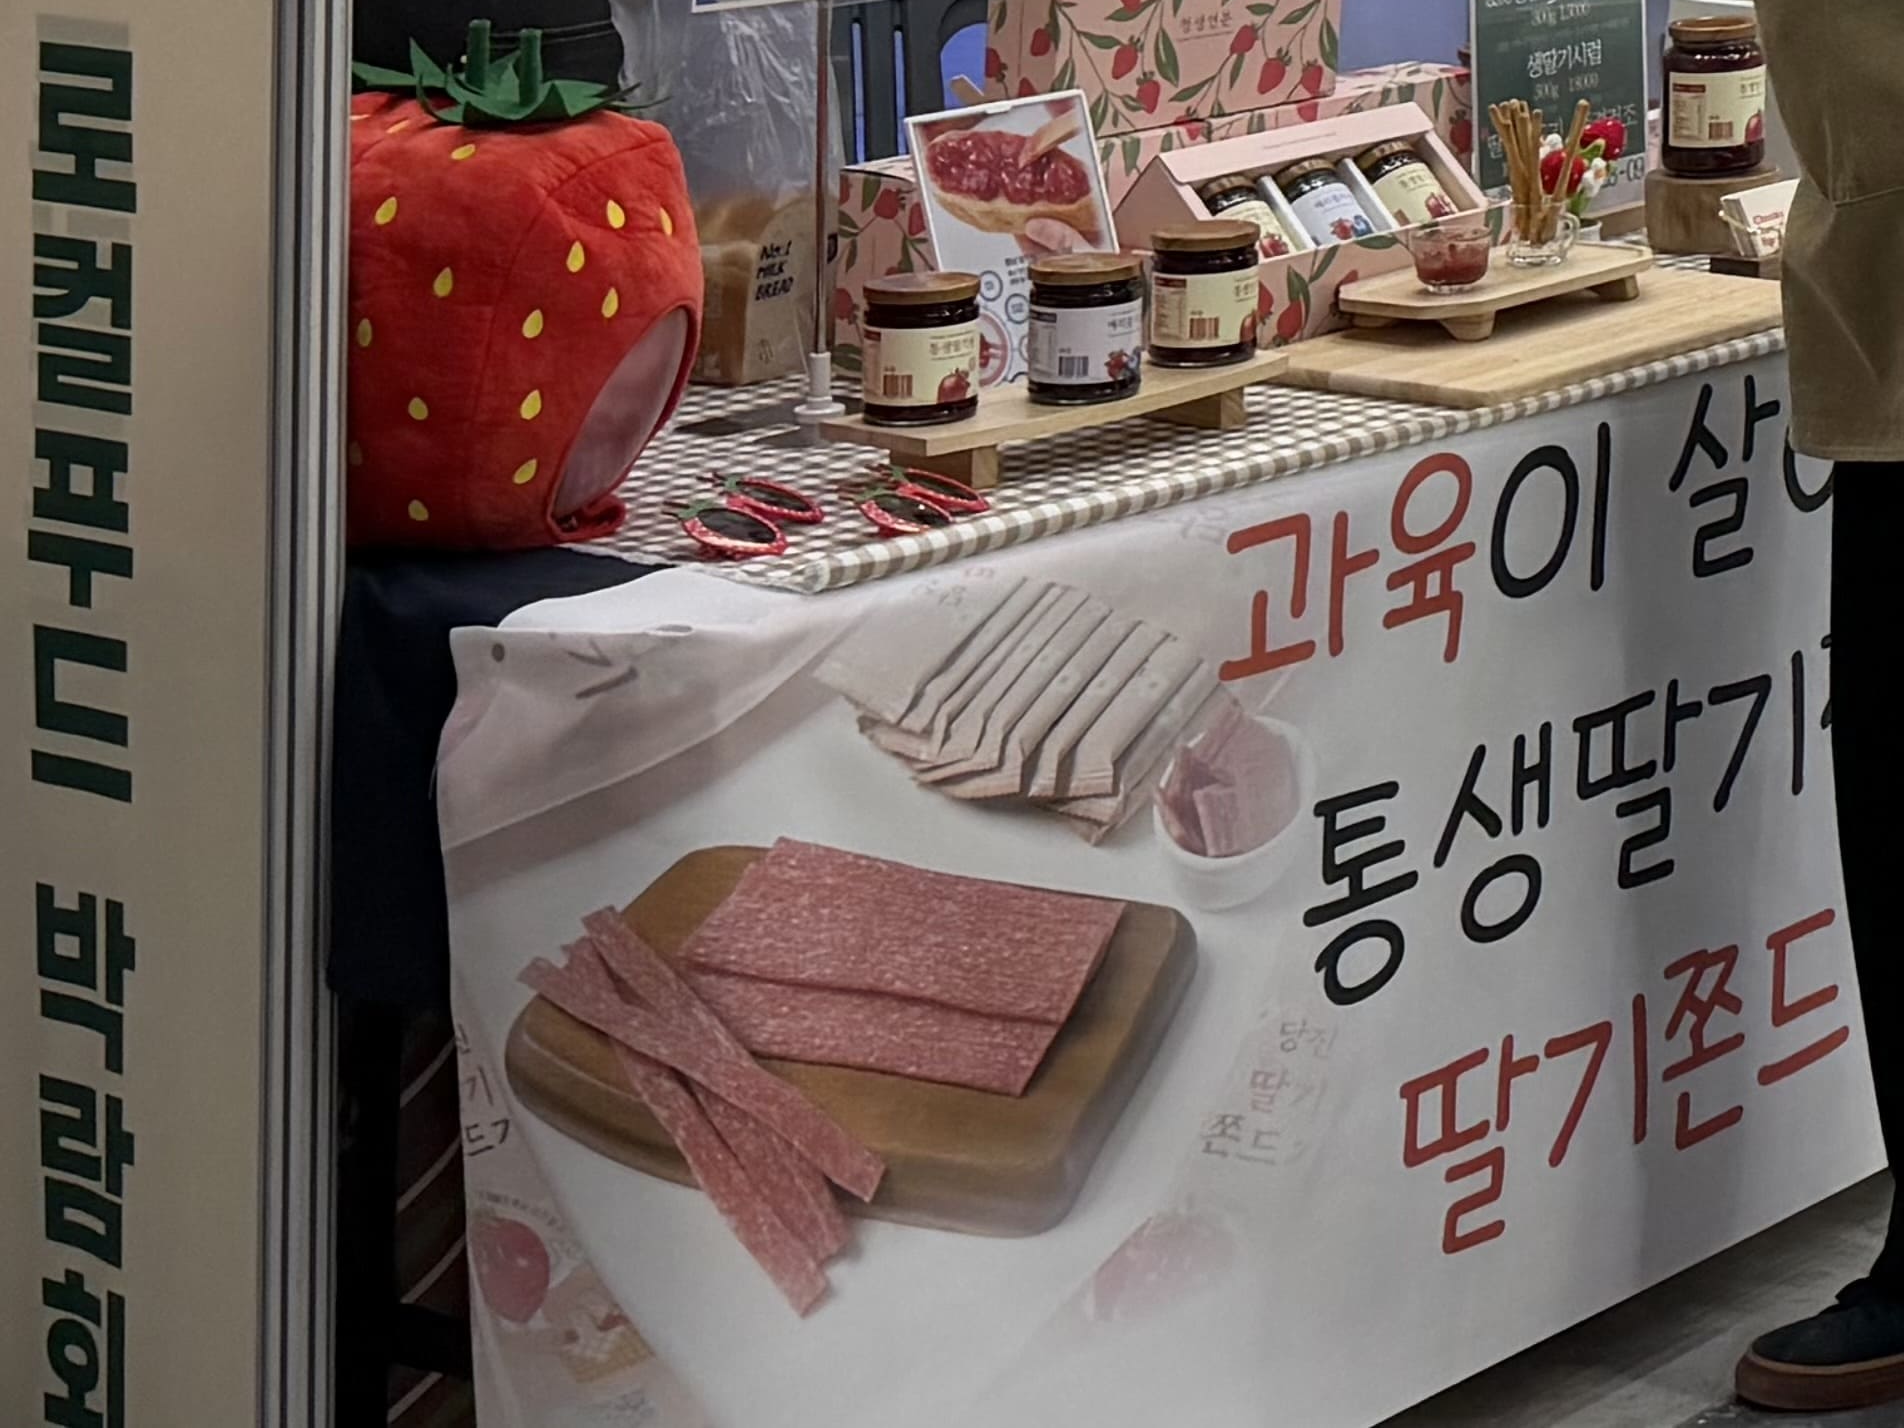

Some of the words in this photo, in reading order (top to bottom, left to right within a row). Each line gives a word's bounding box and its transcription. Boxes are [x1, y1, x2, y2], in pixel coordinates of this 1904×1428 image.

[28, 40, 138, 804] 로컬푸드
[1219, 421, 1611, 683] 과육이
[1303, 634, 1832, 1005] 통생딸기
